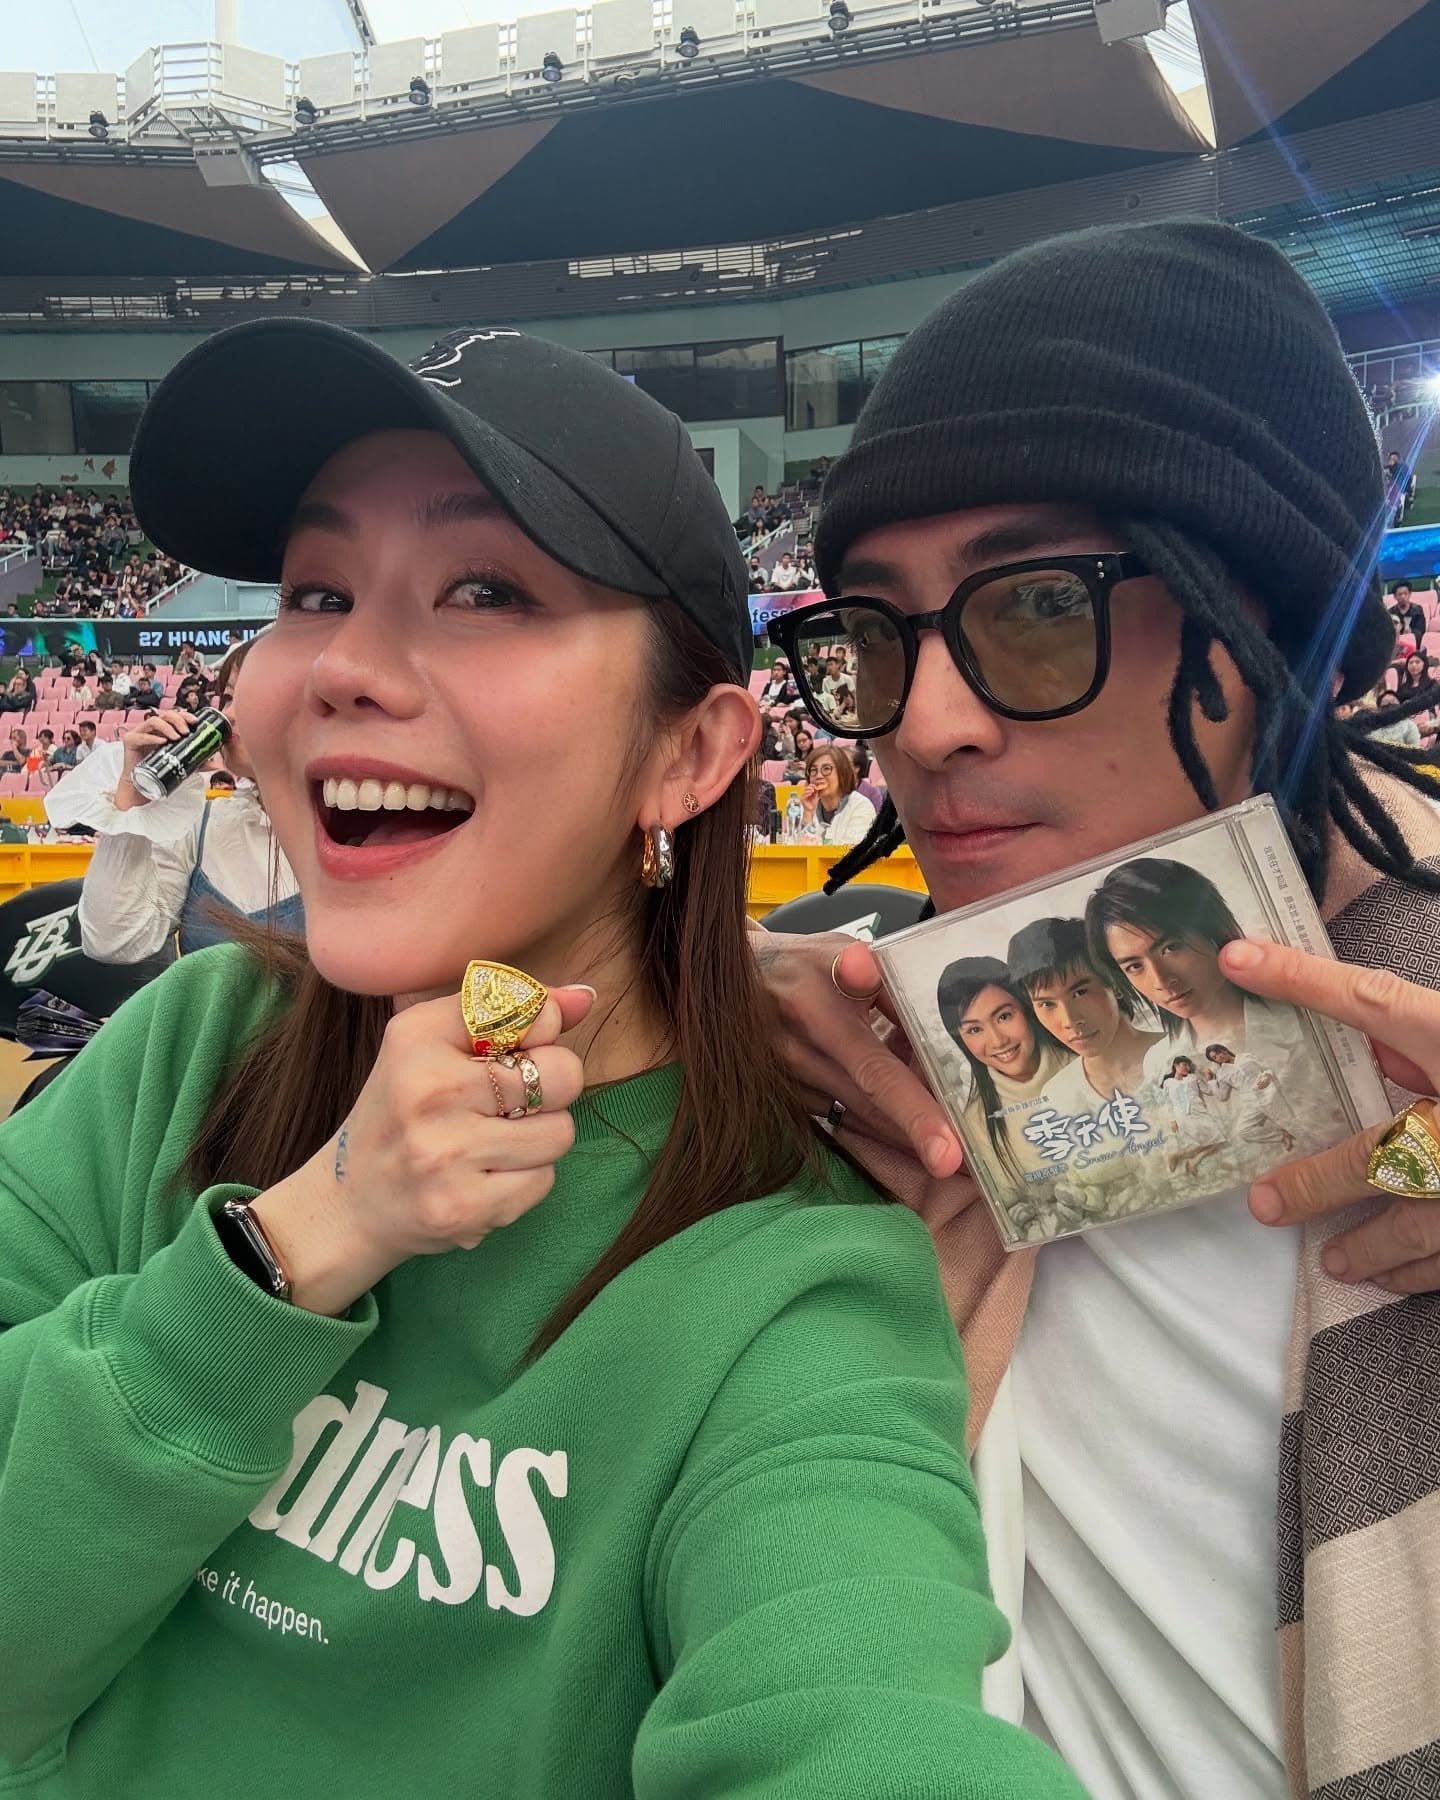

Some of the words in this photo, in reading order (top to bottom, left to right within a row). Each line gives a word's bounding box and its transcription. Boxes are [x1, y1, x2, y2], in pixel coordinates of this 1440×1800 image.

[139, 631, 163, 647] 27
[1024, 1088, 1148, 1161] 雪天使
[222, 1570, 241, 1605] it
[241, 1580, 329, 1645] happen.
